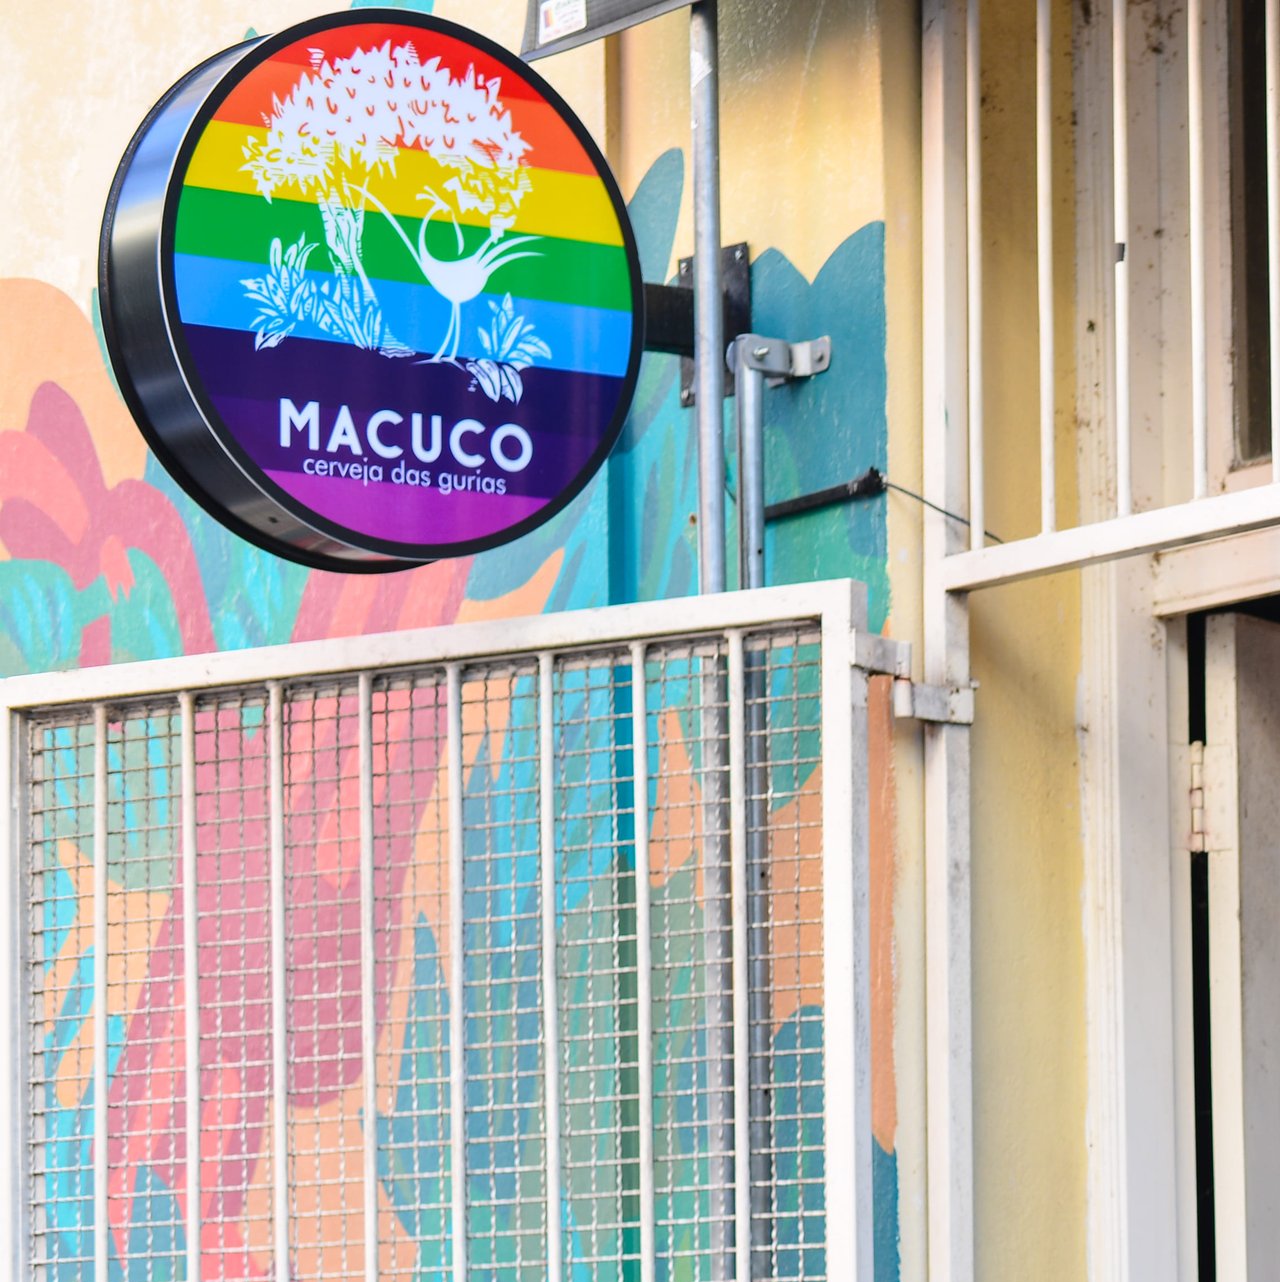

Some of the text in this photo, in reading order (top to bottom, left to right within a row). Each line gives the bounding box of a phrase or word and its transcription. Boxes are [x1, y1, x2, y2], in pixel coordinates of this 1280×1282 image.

[280, 397, 533, 473] MACUCO
[303, 456, 507, 495] cerveja das gurias
